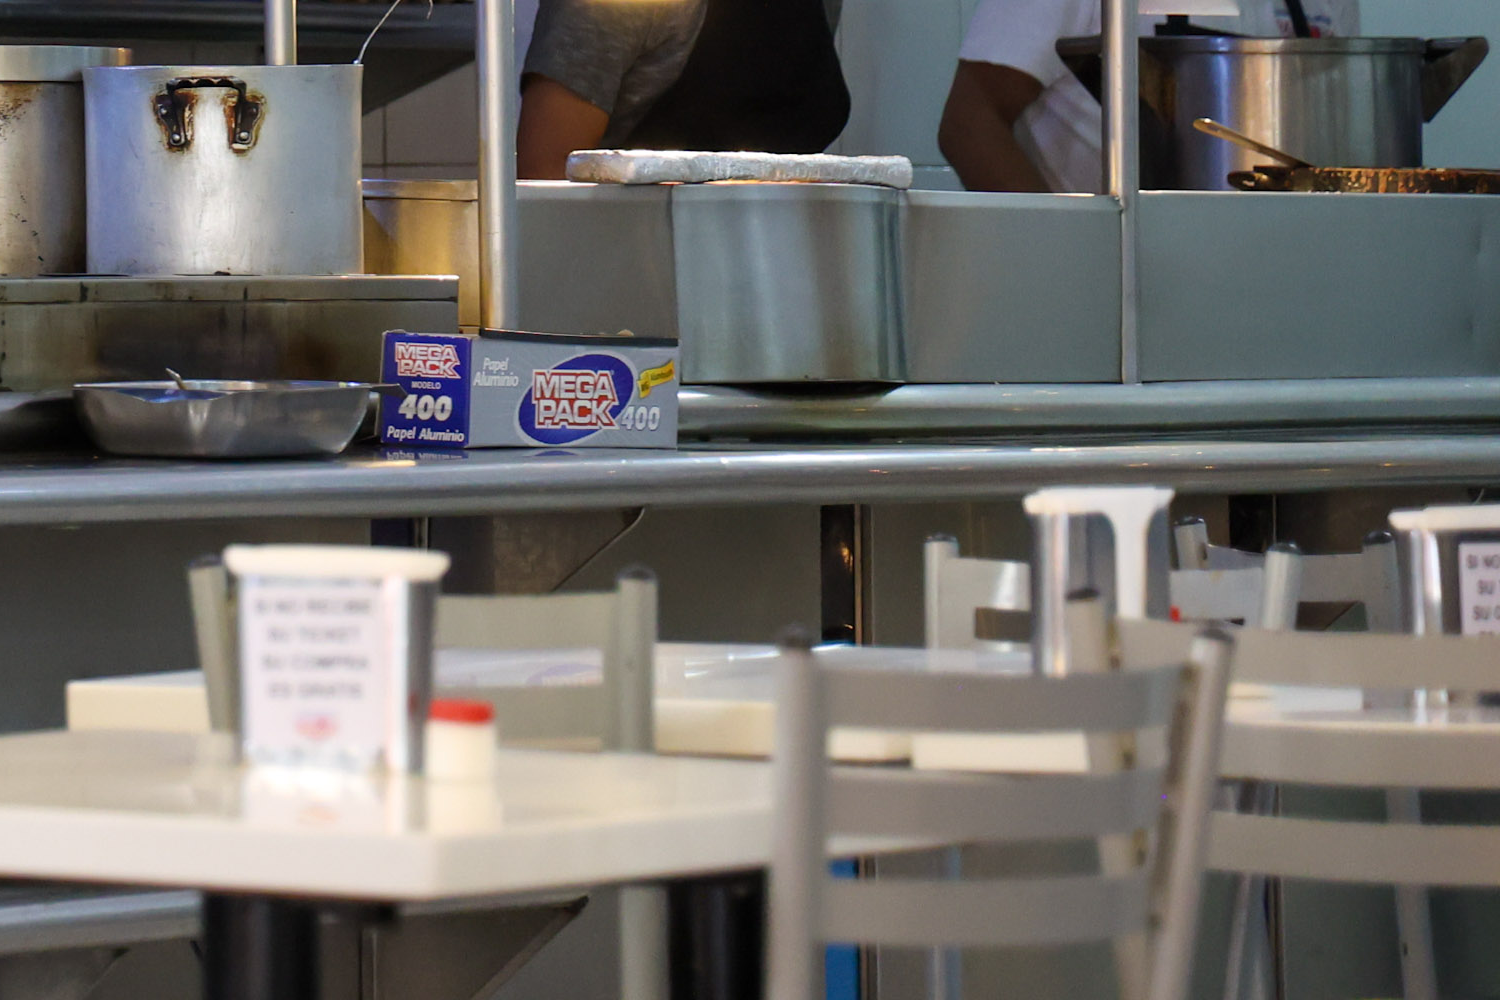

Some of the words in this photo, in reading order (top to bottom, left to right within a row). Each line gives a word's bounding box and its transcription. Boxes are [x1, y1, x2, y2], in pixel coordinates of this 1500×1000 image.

[395, 342, 458, 362] MEGA
[398, 360, 461, 379] PACK
[483, 357, 510, 375] Papel
[411, 381, 442, 390] MODELO
[473, 371, 520, 388] Aluminio
[533, 370, 618, 403] MEGA
[398, 394, 453, 421] 400
[536, 399, 618, 429] PACK
[621, 405, 660, 431] 400
[387, 425, 416, 441] Papel
[418, 428, 465, 442] Aluminio
